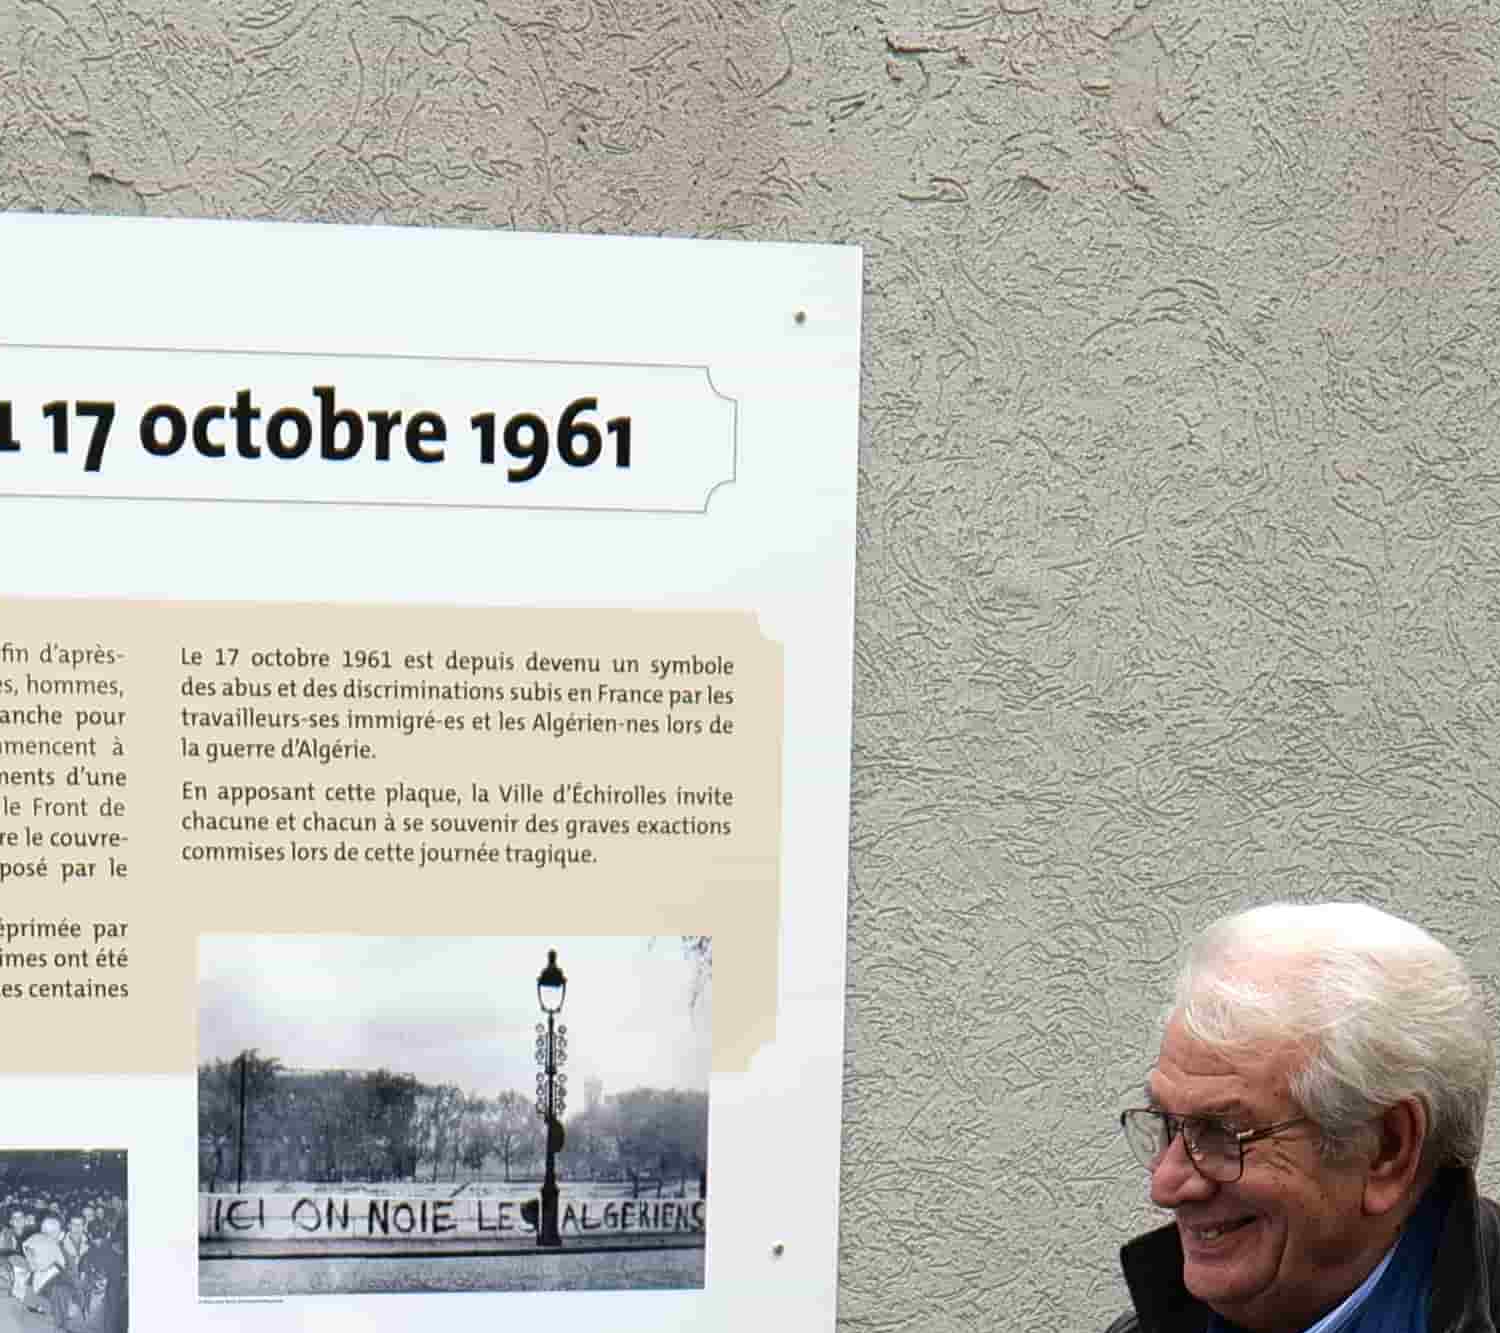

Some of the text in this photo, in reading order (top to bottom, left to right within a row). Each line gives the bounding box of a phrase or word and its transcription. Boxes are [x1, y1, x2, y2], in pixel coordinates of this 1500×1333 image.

[41, 399, 118, 473] 17
[139, 385, 448, 464] octobre
[469, 396, 633, 484] 1961
[1, 642, 28, 662] fin
[39, 643, 122, 670] d'après-
[181, 647, 733, 679] Le 17 octobre 1961 est depuis devenu un symbole
[181, 675, 733, 710] des abus et des discriminations subis en France par les
[75, 711, 125, 731] pour
[111, 735, 123, 756] à
[180, 736, 375, 764] la guerre d'Algérie.
[66, 765, 126, 786] d'une
[3, 795, 21, 816] le
[33, 797, 87, 816] Front
[99, 796, 125, 816] de
[182, 781, 733, 808] En apposant cette plaque, la Ville d'Échirolles invite
[25, 826, 42, 846] le
[49, 831, 128, 847] couvre-
[181, 809, 731, 839] chacune et chacun à se souvenir des graves exactions
[181, 840, 596, 869] commises lors de cette journée tragique.
[61, 863, 96, 883] par
[108, 856, 127, 877] le
[92, 923, 128, 944] par
[53, 949, 88, 968] ont
[95, 947, 128, 968] été
[28, 978, 128, 998] centaines
[214, 1197, 265, 1232] ICI
[291, 1197, 350, 1232] ON
[561, 1199, 706, 1234] ALGERIENS
